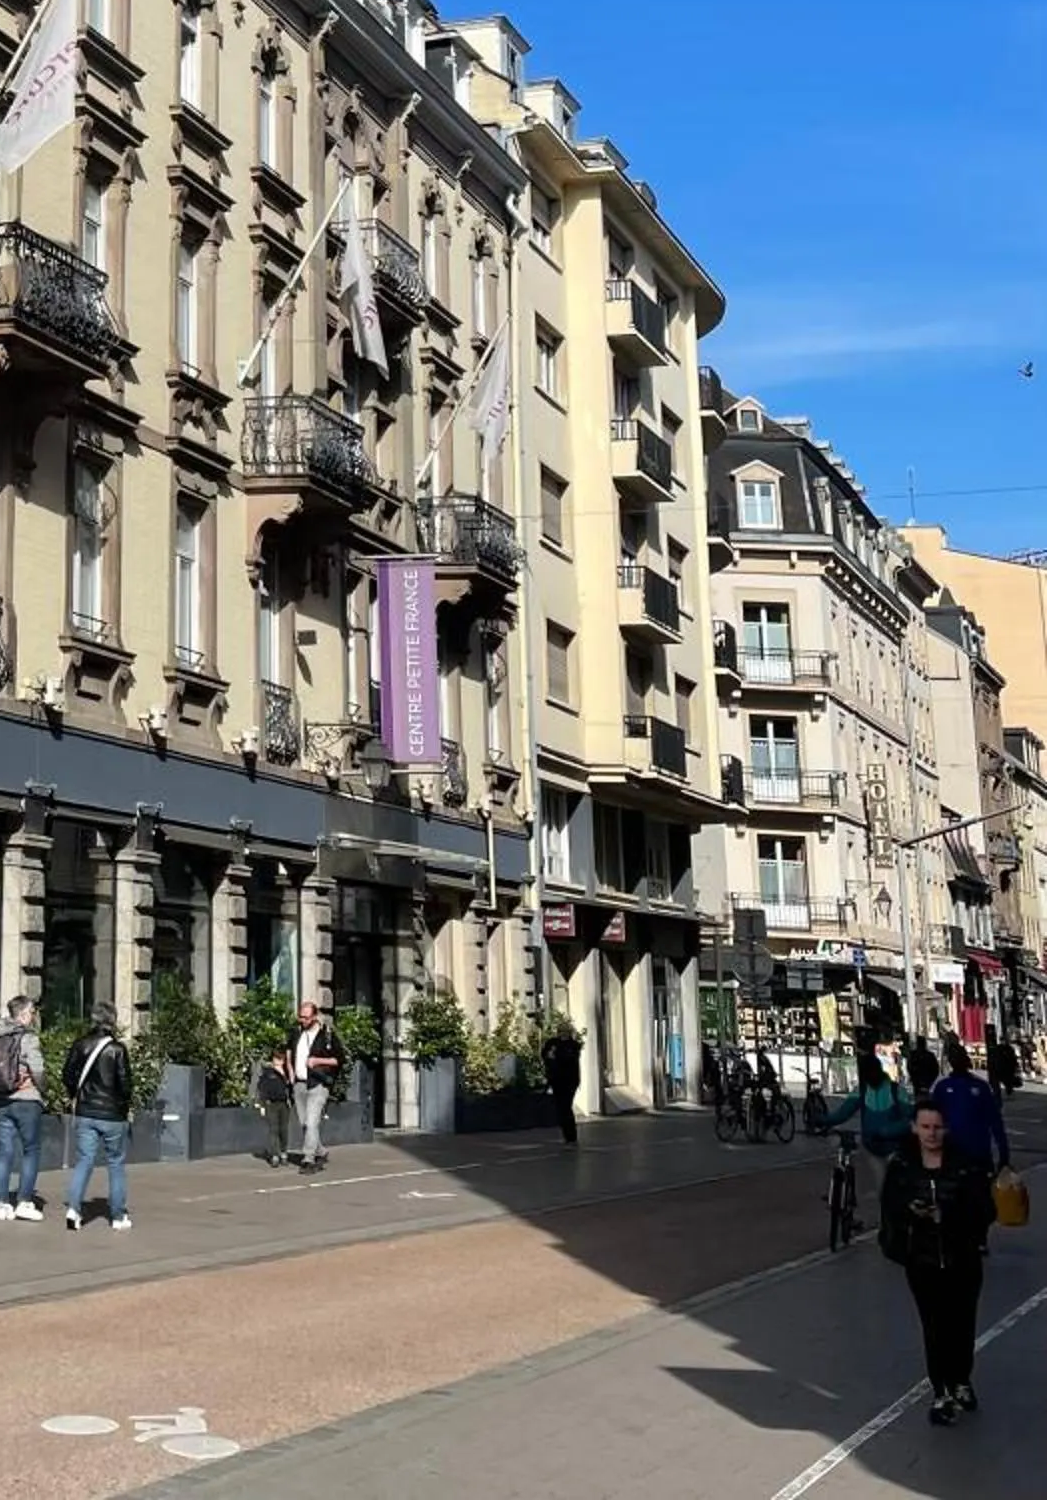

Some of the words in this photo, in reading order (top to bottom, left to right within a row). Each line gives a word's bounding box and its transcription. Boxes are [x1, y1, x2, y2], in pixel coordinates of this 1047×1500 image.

[403, 568, 422, 632] FRANCE
[405, 633, 423, 690] PETITE
[408, 692, 425, 757] CENTRE
